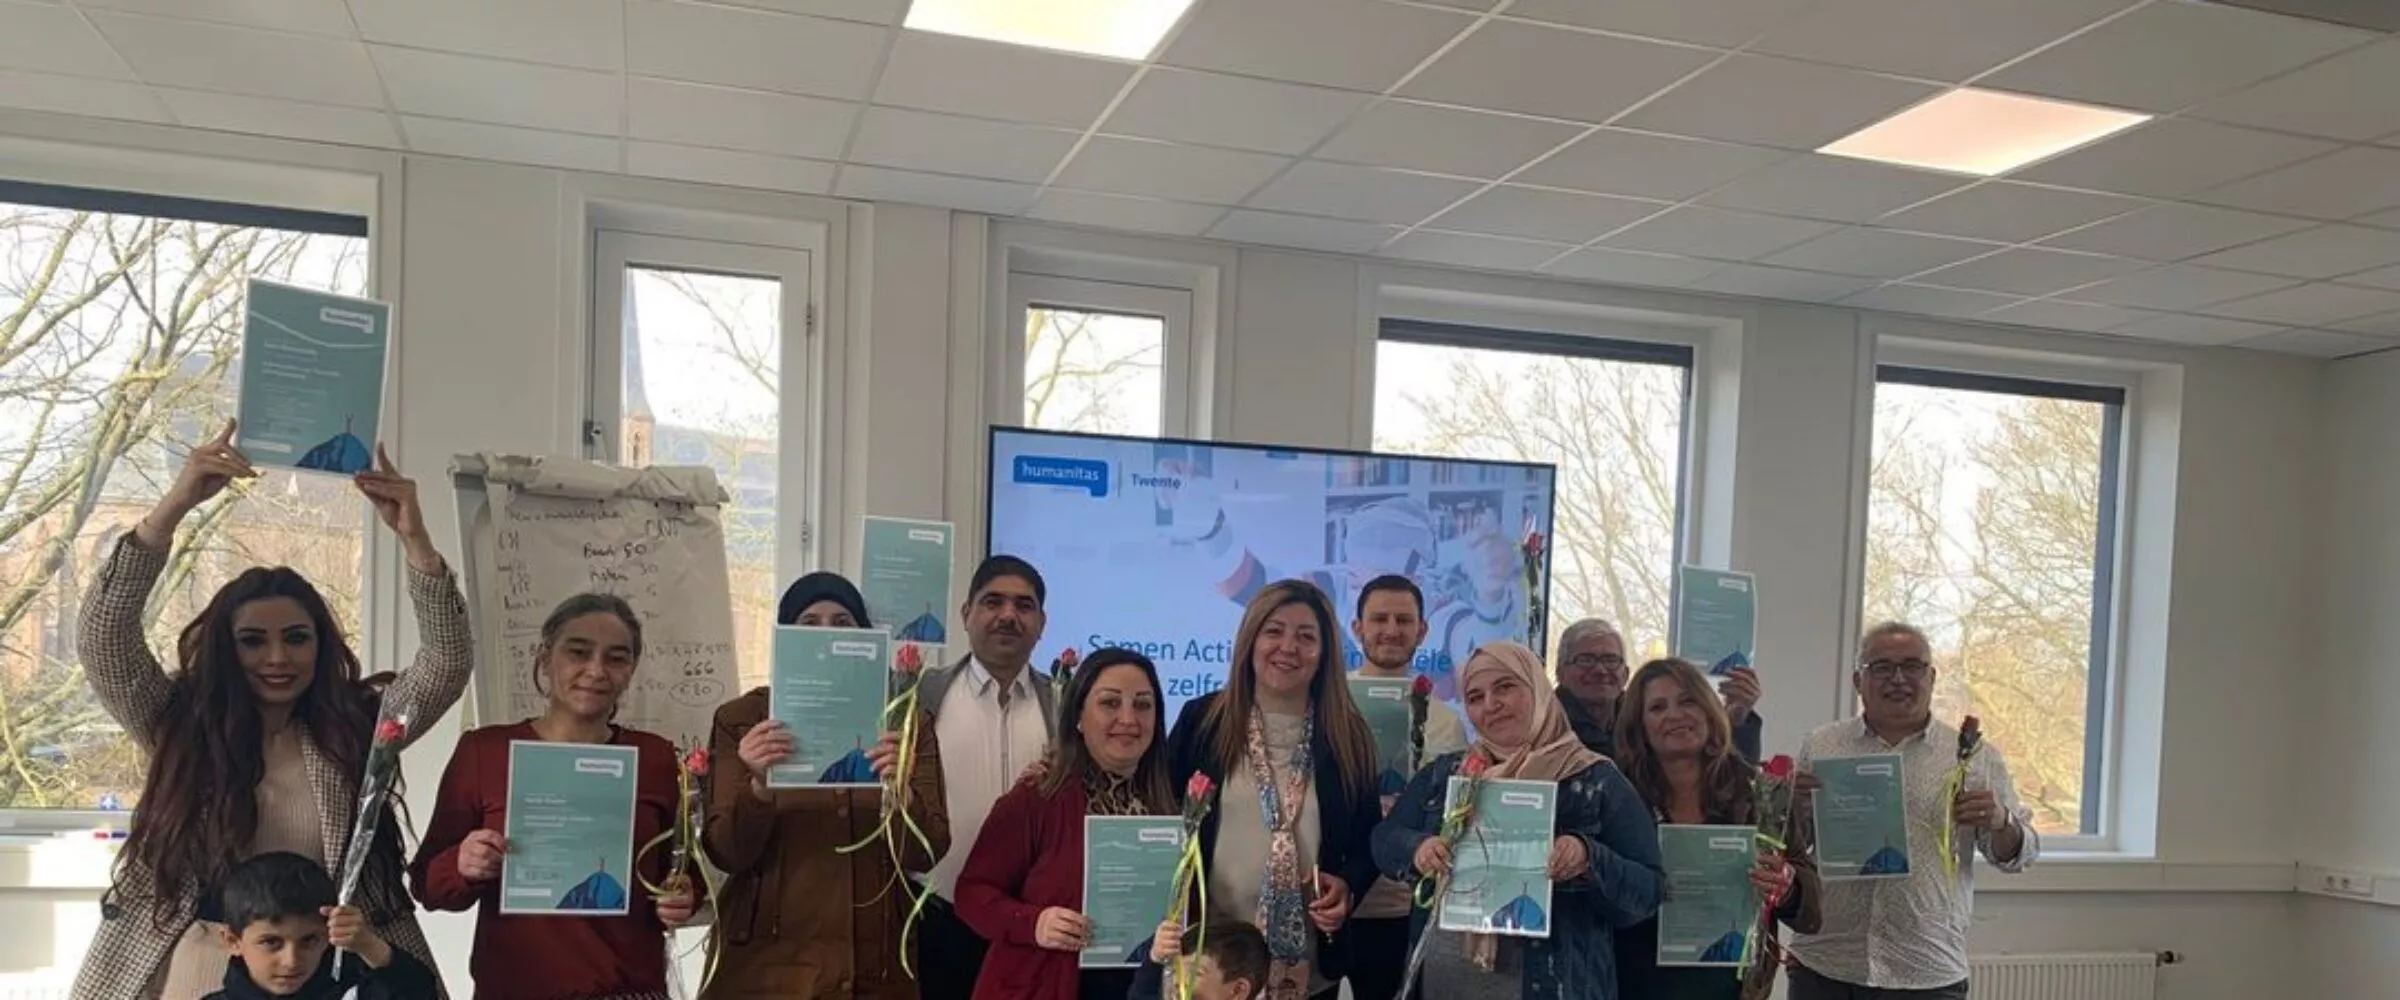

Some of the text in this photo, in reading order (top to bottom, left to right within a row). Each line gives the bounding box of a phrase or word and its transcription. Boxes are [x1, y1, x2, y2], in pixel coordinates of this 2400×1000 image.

[1022, 461, 1099, 481] humanitas
[1131, 473, 1181, 489] Twente
[1184, 639, 1232, 664] Acti
[1168, 672, 1223, 696] zelfr
